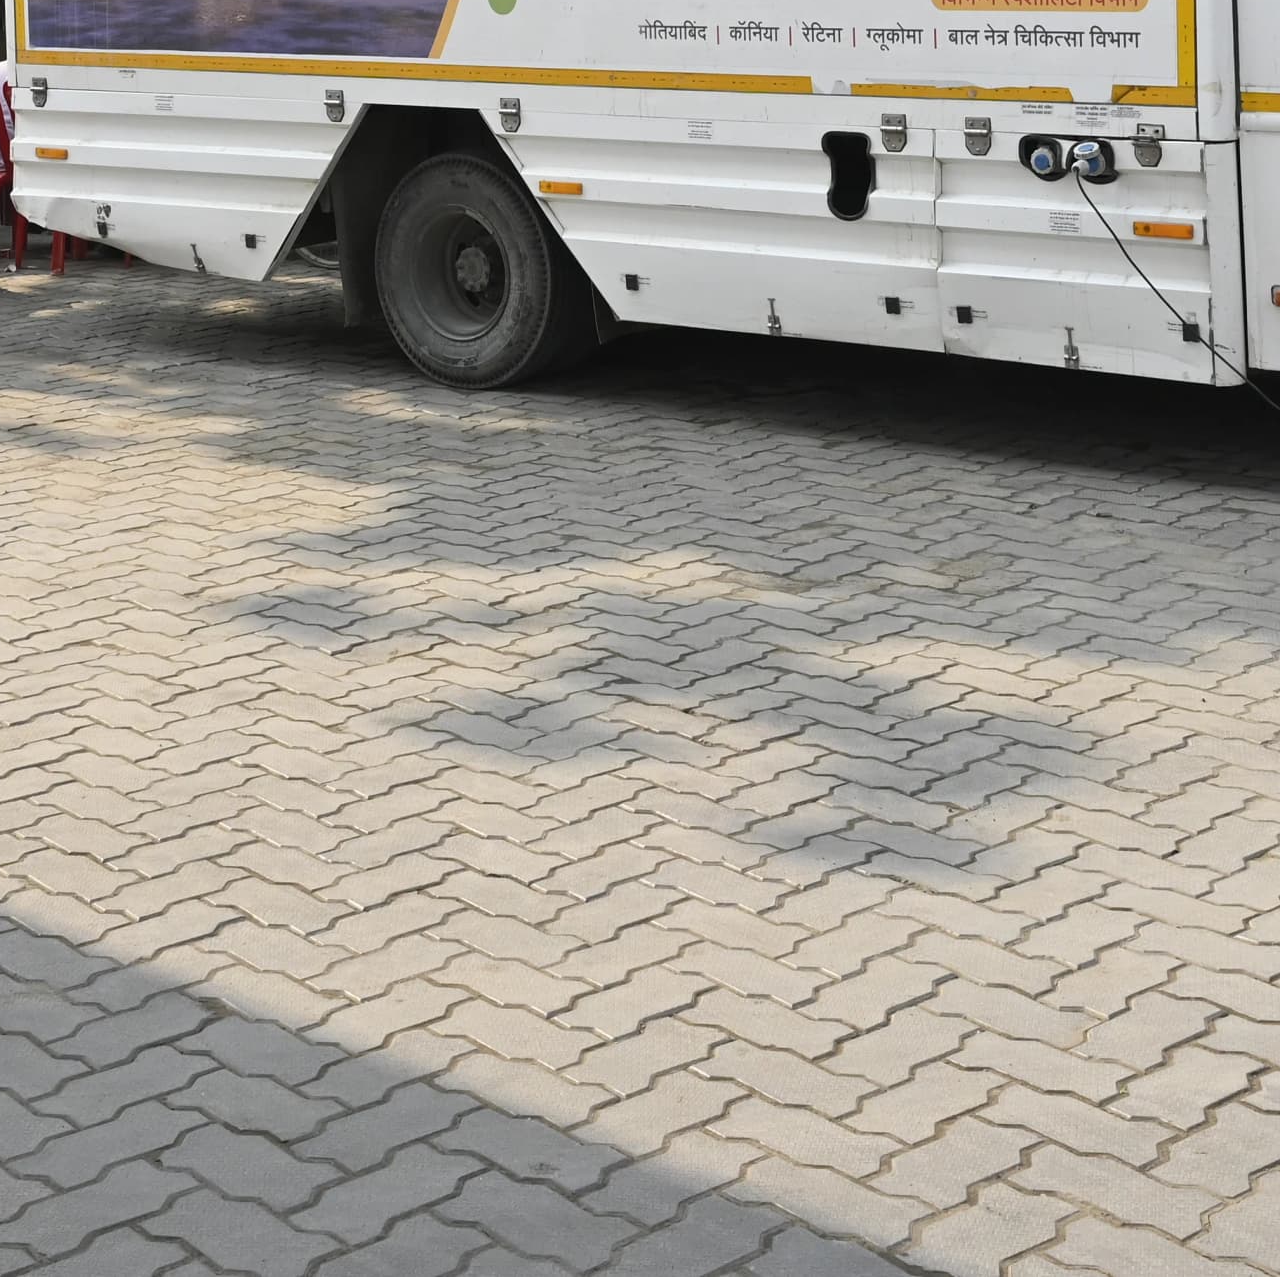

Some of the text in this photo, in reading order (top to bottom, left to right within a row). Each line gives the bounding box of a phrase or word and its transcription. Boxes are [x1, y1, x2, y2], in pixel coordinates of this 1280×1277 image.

[638, 19, 1141, 51] मोतियाबिंद कॉर्निया रेटिना ग्लूकोमा बाल नेत्र चिकित्सा विभाग
